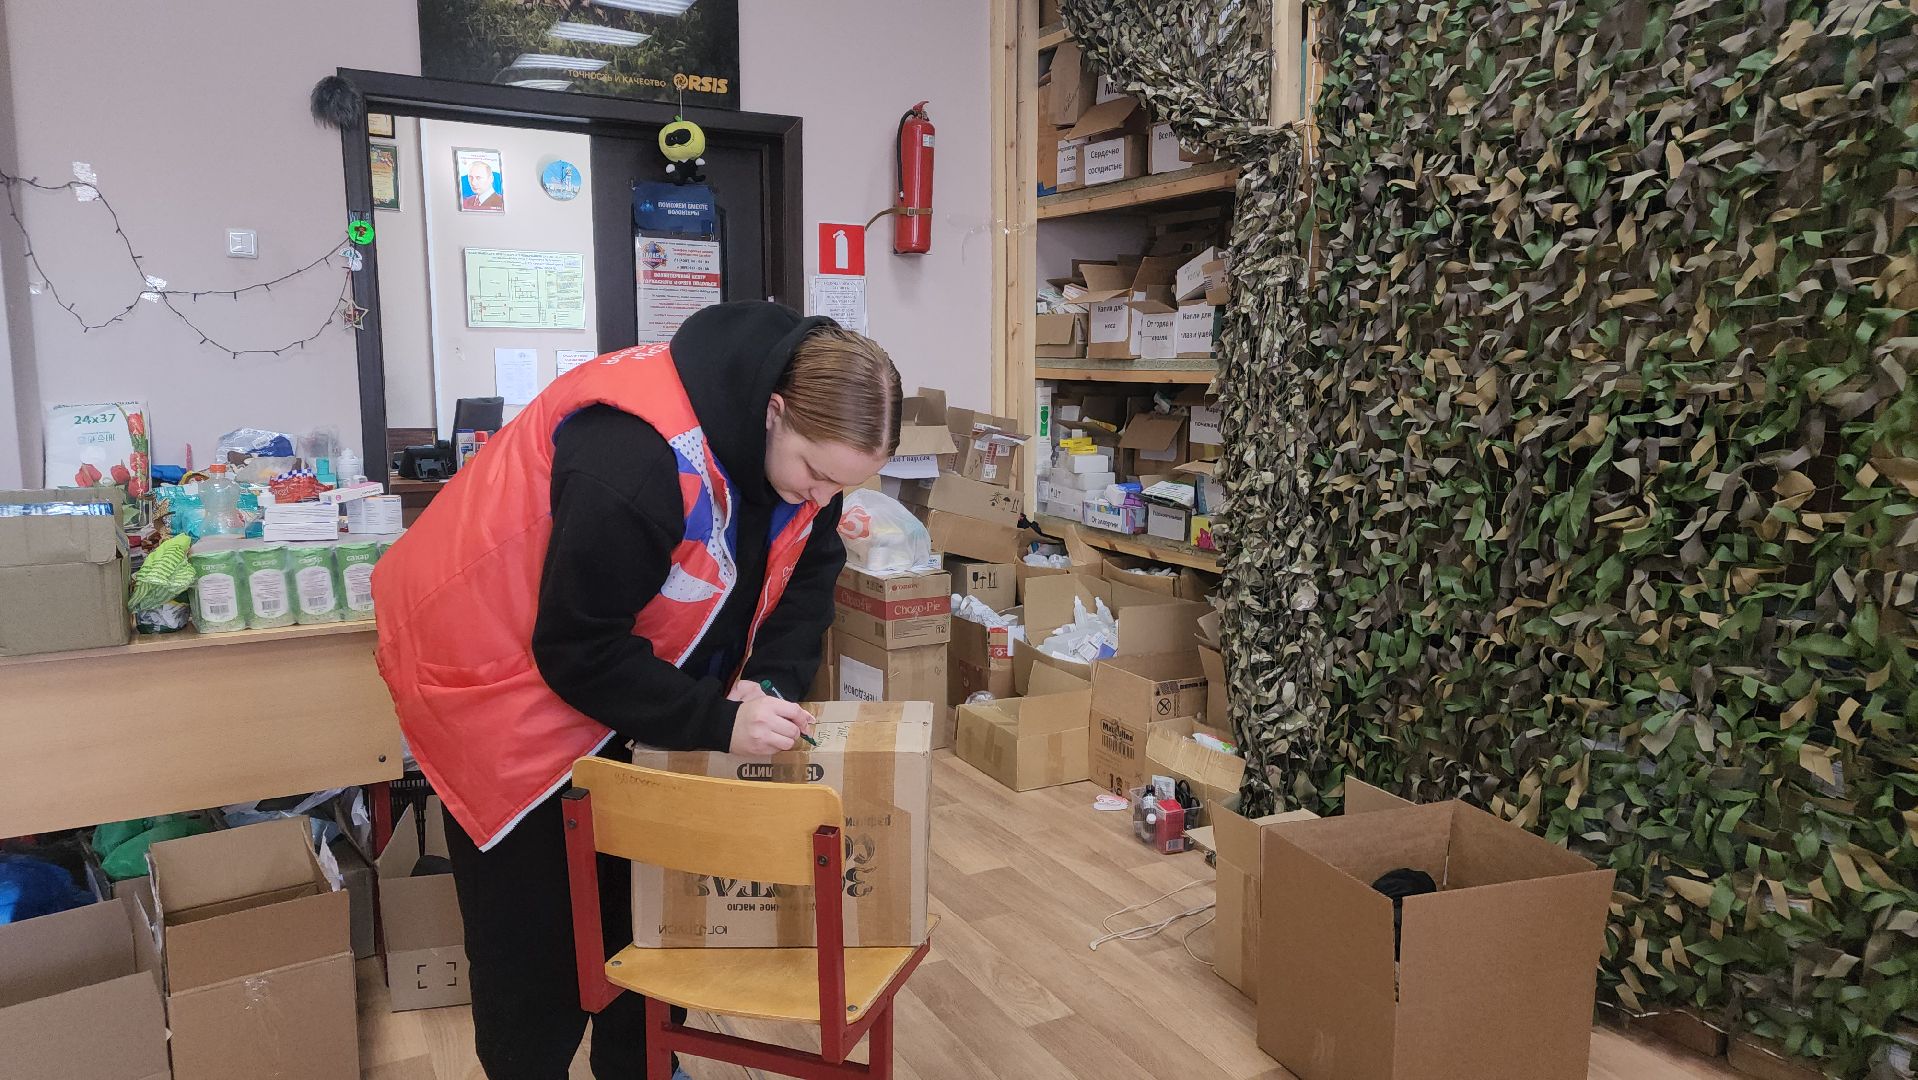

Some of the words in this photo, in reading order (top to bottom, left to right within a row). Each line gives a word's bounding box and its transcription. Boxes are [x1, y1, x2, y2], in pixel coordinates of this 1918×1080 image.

[567, 69, 613, 82] ТОЧНОСТЬ
[614, 74, 621, 83] И
[622, 75, 667, 88] КАЧЕСТВО
[673, 73, 728, 94] ORSIS
[1090, 147, 1119, 159] Сердечно
[1088, 163, 1122, 175] сосудистые
[73, 413, 116, 425] 24x37
[346, 553, 370, 562] сахар
[727, 903, 756, 912] масло
